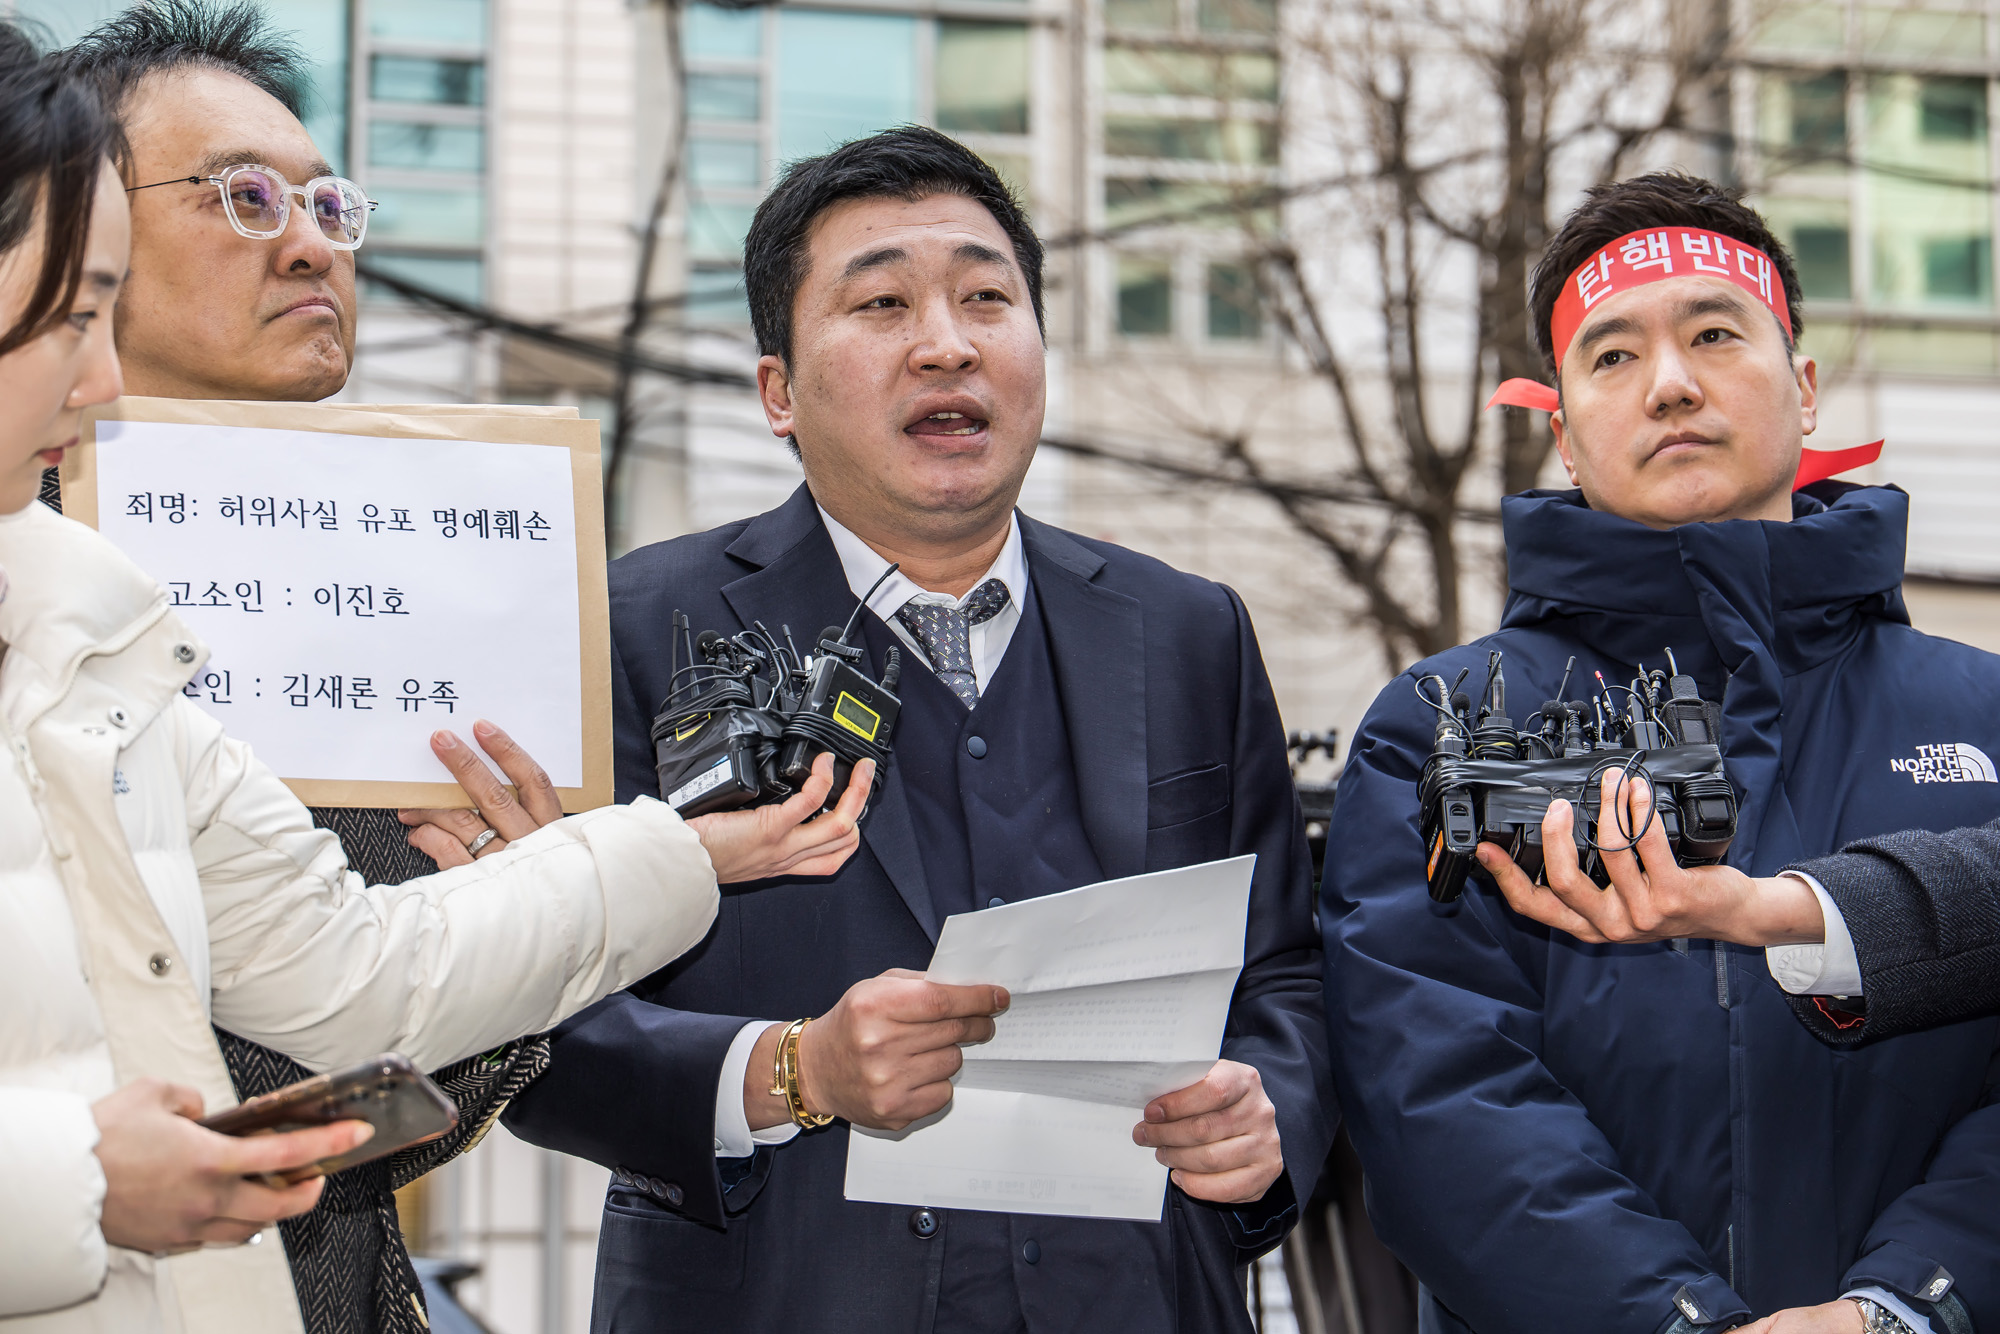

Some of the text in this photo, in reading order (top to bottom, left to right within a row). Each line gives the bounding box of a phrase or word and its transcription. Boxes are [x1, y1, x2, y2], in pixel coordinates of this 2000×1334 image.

[126, 491, 552, 541] 죄명: 허위사실 유포 명예훼손
[314, 583, 410, 618] 이진호
[282, 673, 378, 710] 김새론
[395, 678, 459, 714] 유족
[1915, 743, 1955, 758] THE
[1890, 756, 1960, 773] NORTH
[1912, 768, 1964, 784] FACE
